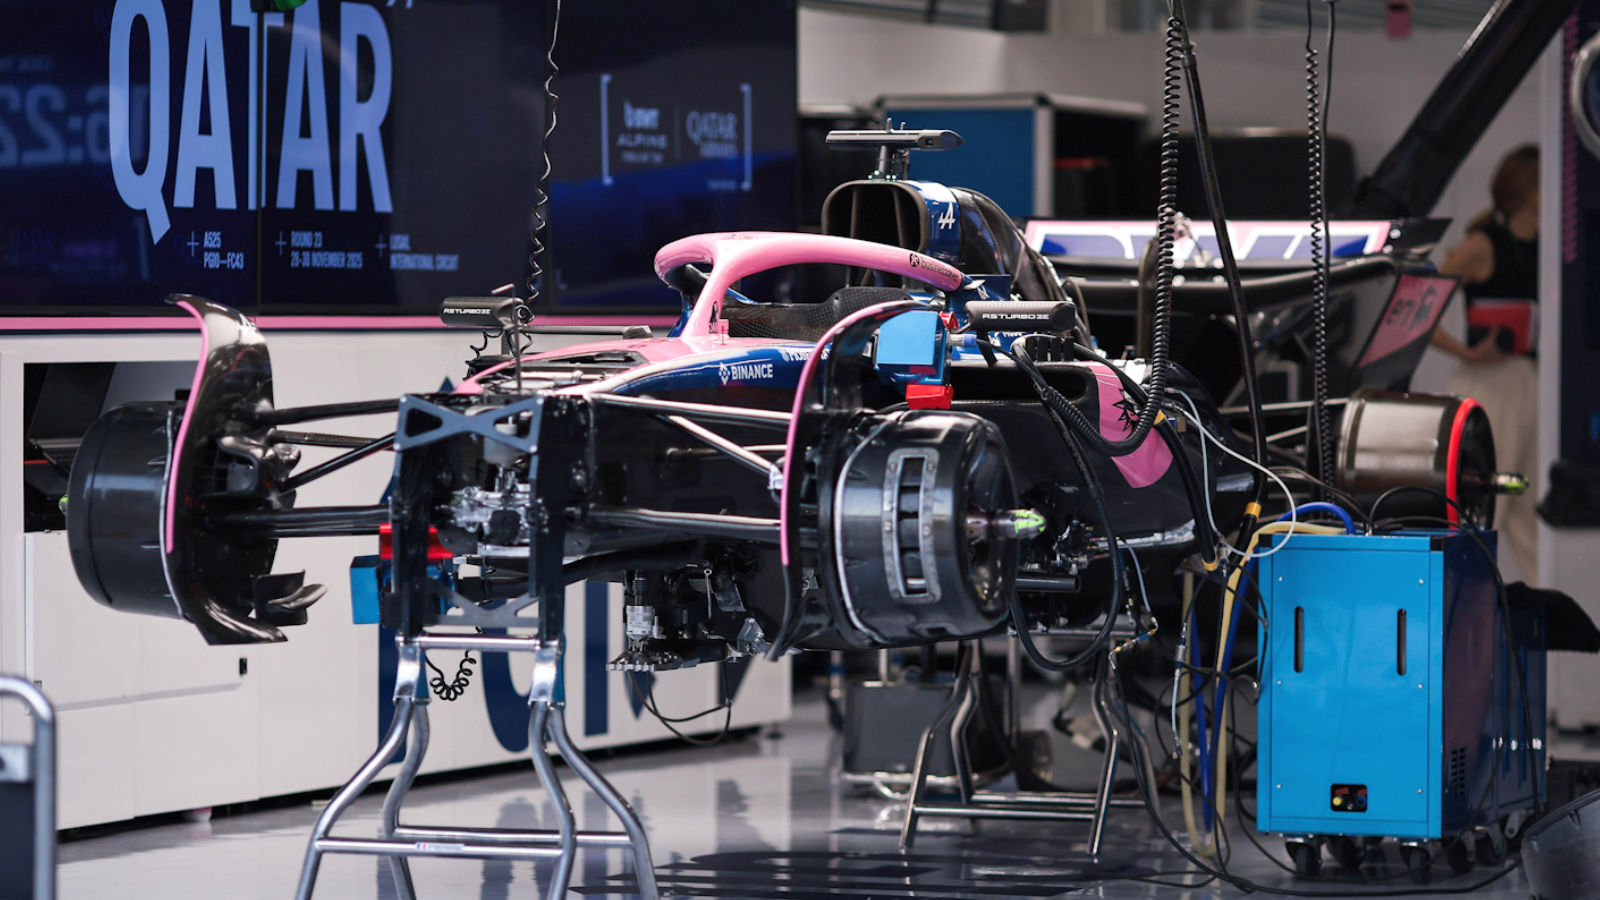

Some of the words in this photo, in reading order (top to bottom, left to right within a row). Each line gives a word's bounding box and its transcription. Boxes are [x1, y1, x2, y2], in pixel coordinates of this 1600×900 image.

[109, 0, 393, 244] QATAR
[685, 110, 738, 146] QATAR
[616, 133, 668, 149] ALPINE
[290, 231, 313, 248] ROUND
[311, 251, 346, 268] NOVEMBER
[347, 252, 363, 269] 2025
[731, 363, 774, 380] BINANCE
